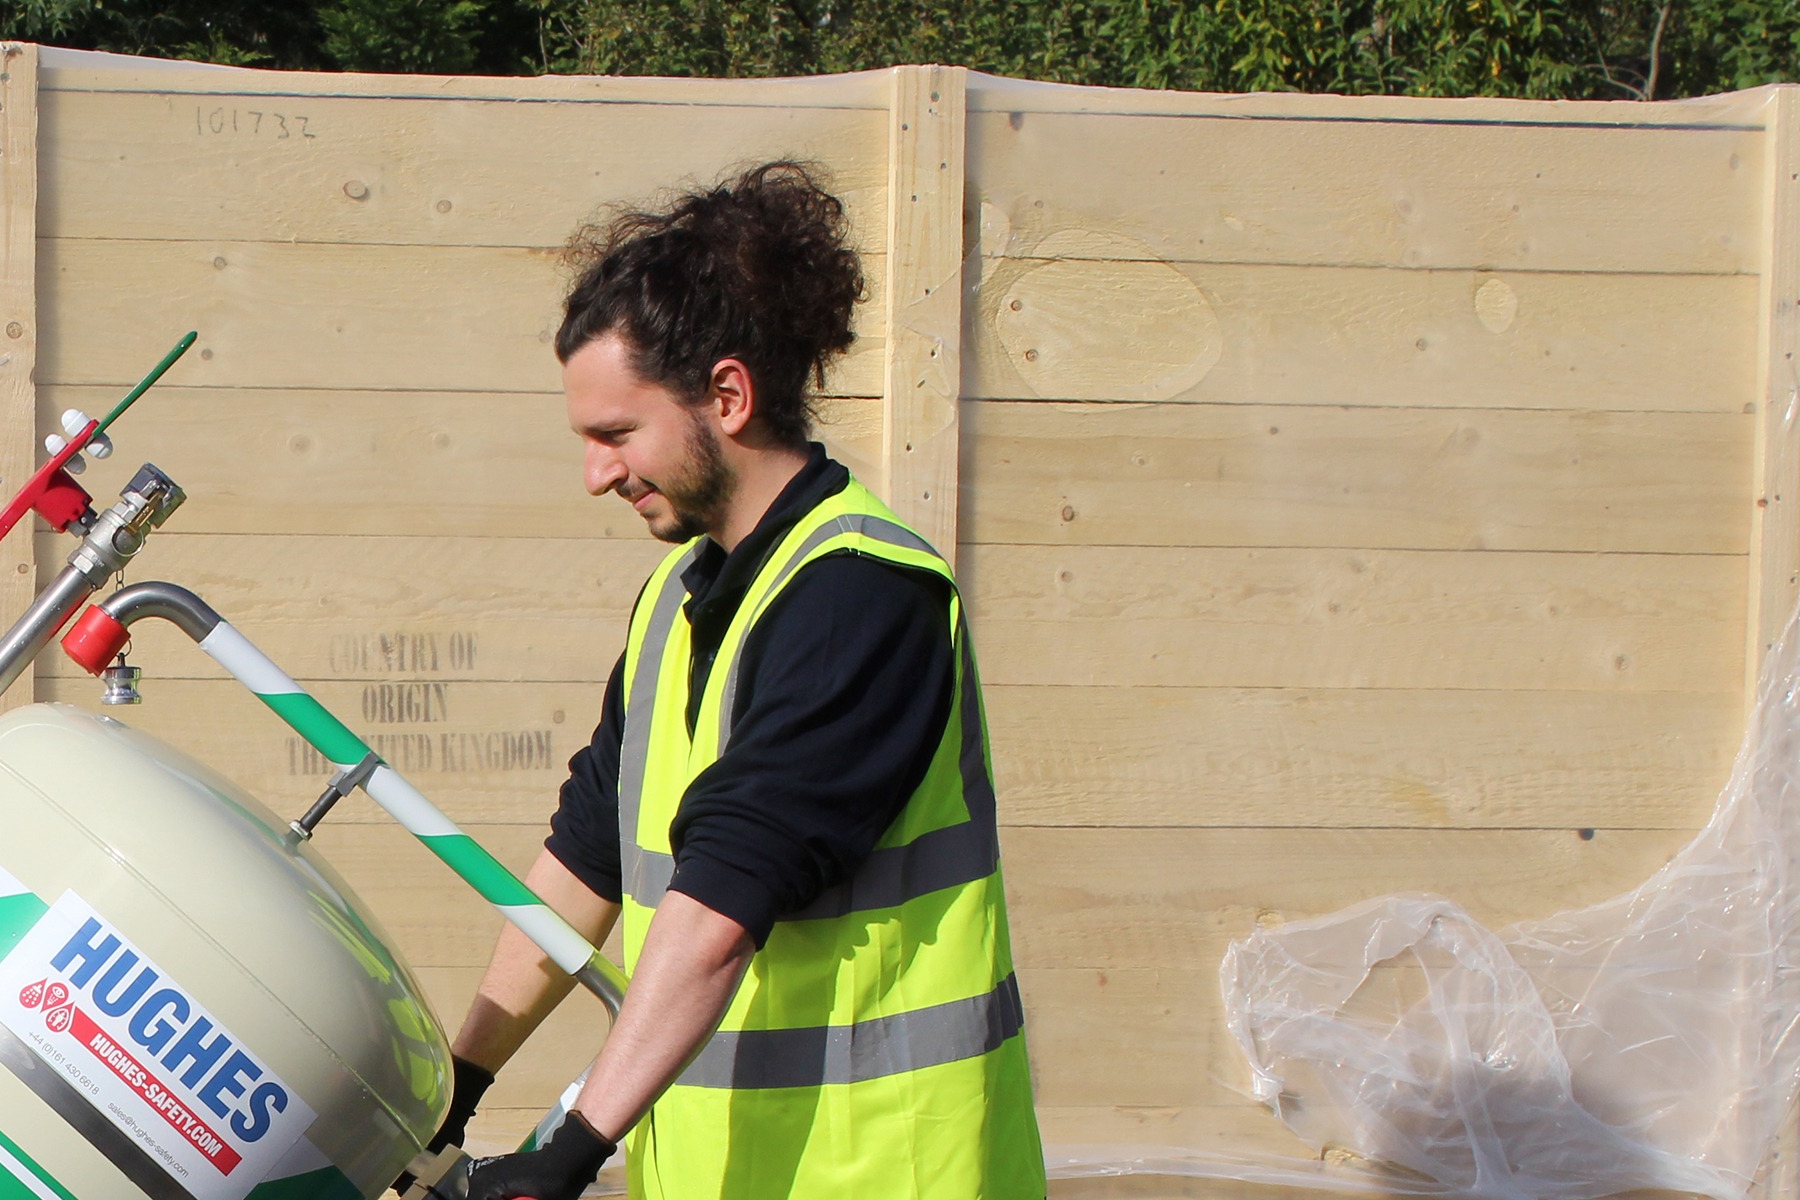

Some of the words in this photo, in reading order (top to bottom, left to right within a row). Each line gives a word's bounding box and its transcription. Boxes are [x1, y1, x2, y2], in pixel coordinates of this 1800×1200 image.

[196, 105, 316, 139] 101732
[328, 631, 441, 673] COUNTRY
[450, 631, 479, 671] OF
[361, 683, 449, 725] ORIGIN
[440, 730, 553, 773] KINGDOM
[50, 916, 289, 1143] HUGHES
[29, 1032, 44, 1045] +44
[42, 1042, 66, 1065] (0)161
[65, 1063, 81, 1078] 430
[79, 1075, 100, 1095] 6618
[89, 1032, 223, 1158] HUGHES-SAFETY.COM
[107, 1101, 189, 1179] sales@hughes-safety.com
